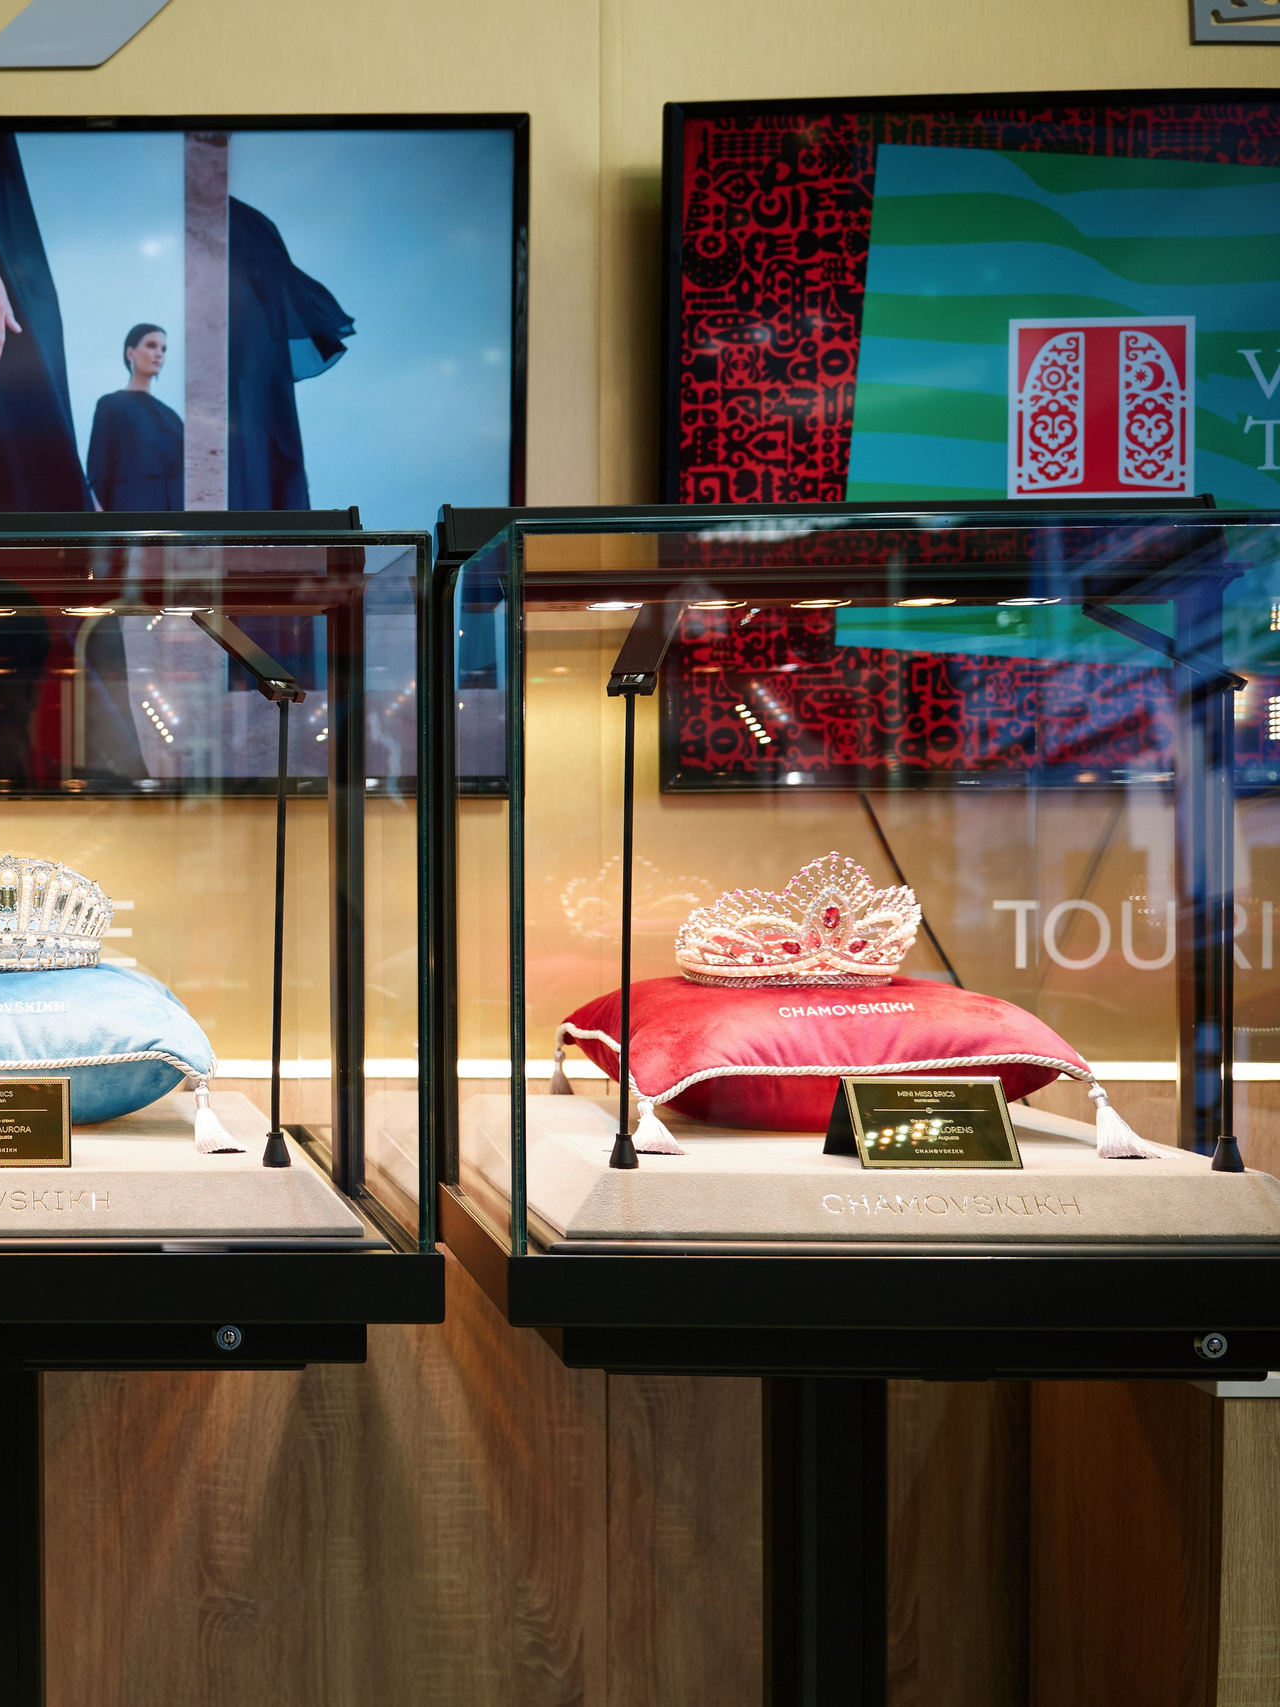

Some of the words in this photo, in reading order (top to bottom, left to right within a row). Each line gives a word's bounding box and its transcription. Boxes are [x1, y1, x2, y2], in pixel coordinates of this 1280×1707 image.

[778, 1002, 915, 1018] CHAMOVSKIKH
[896, 1090, 914, 1098] MINI
[914, 1090, 933, 1098] MISS
[933, 1090, 956, 1098] BRICS
[936, 1126, 974, 1134] LORENS
[821, 1193, 1082, 1216] CHAMOVSKIKH
